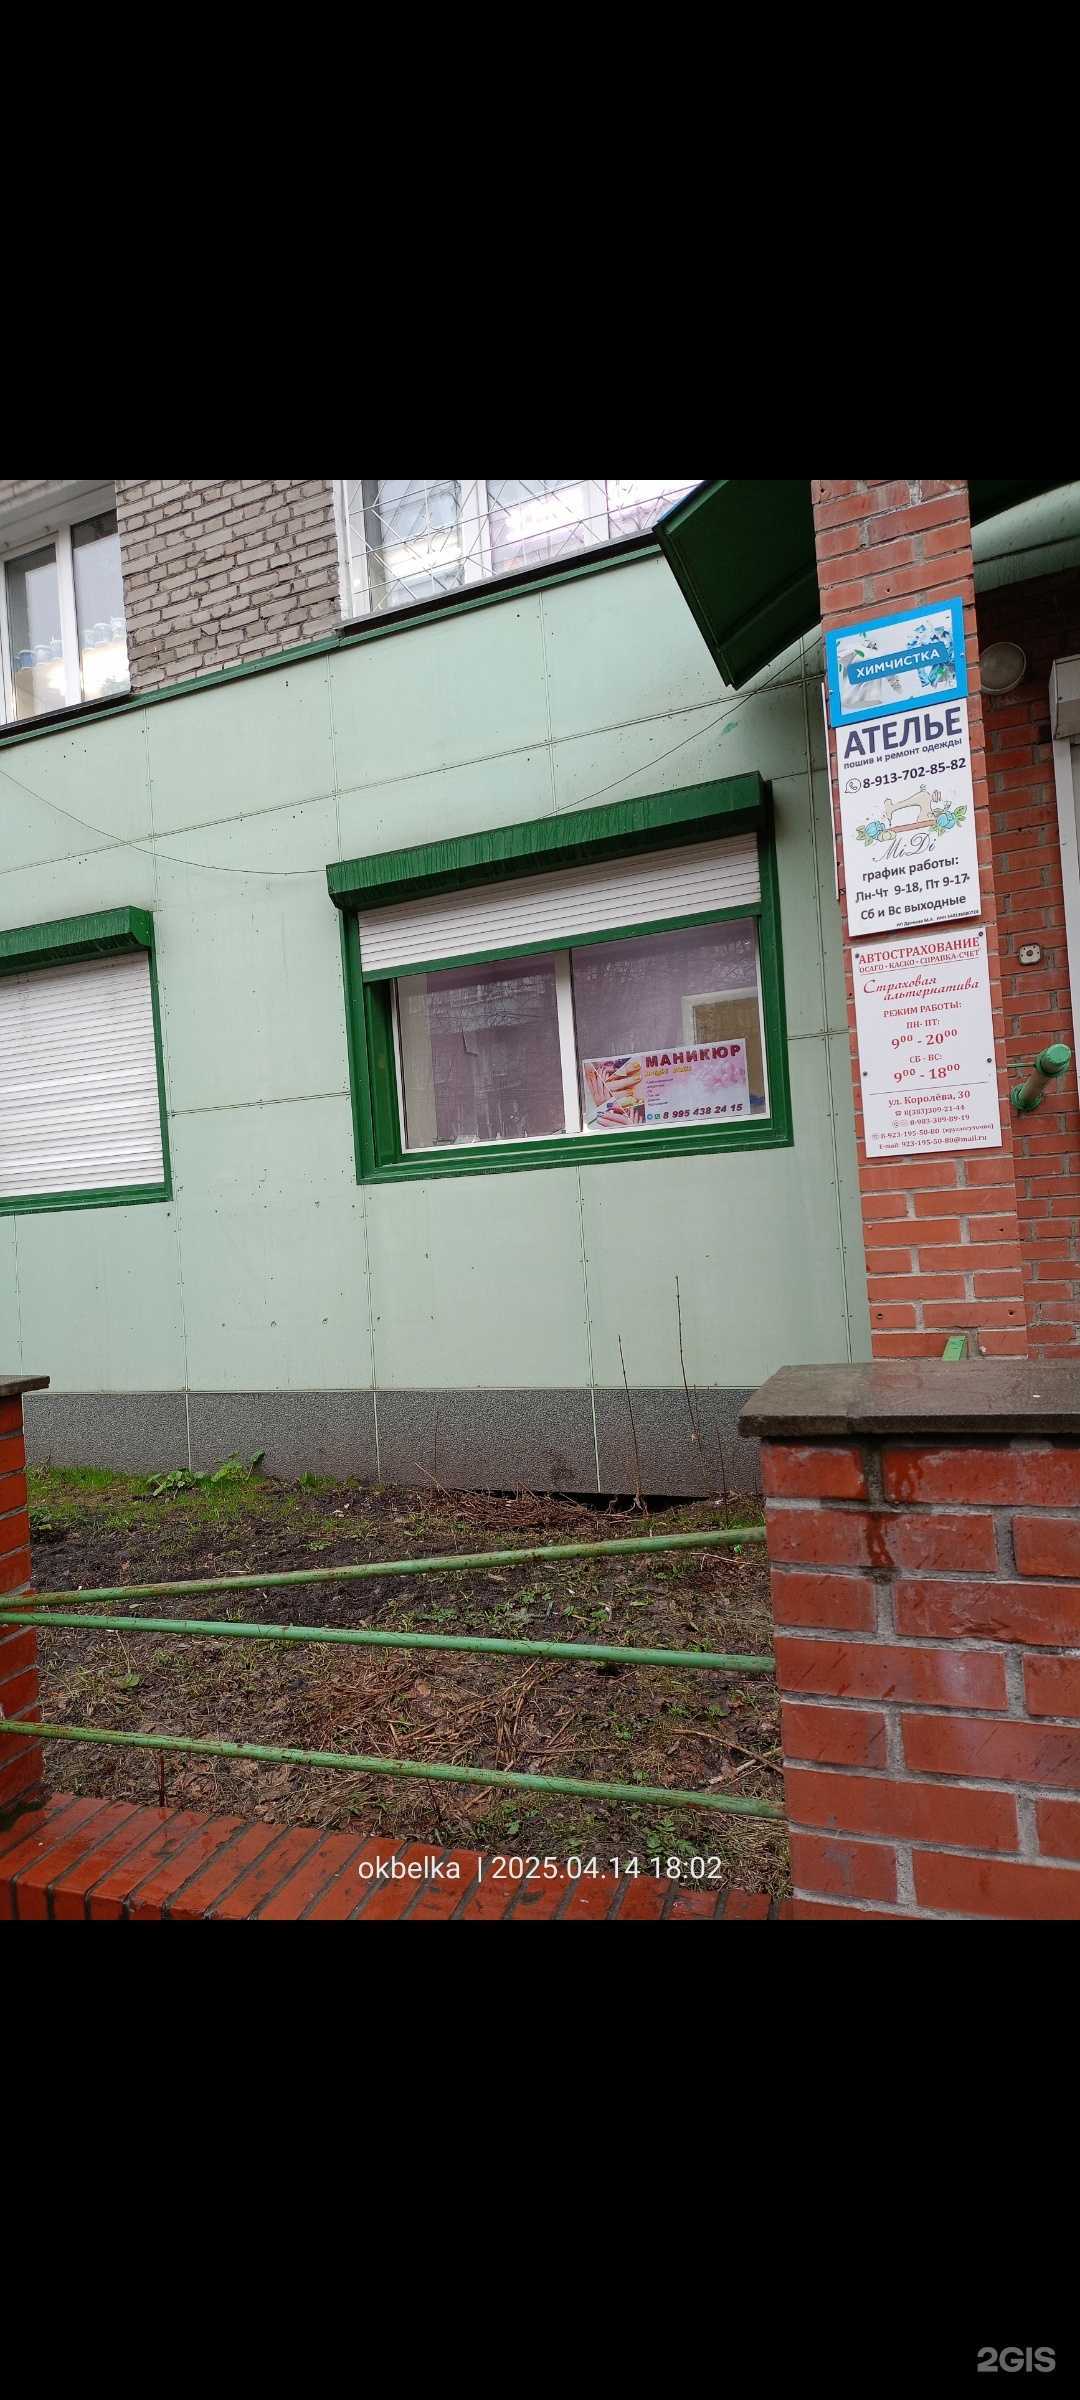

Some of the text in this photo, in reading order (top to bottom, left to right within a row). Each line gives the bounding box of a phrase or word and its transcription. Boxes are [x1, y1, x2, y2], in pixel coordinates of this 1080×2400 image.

[856, 649, 940, 678] ХИМЧИСТКА
[843, 706, 962, 759] АТЕЛЬЕ
[844, 738, 962, 770] пошив и ремонт одежды
[863, 757, 967, 789] 8-913-702-85-82
[862, 856, 959, 883] график работы:
[855, 888, 889, 904] Пн-Чт
[894, 882, 922, 896] 9-18,
[926, 879, 940, 890] Пт
[861, 908, 875, 921] Сб
[878, 909, 885, 918] и
[888, 905, 901, 917] Вс
[904, 895, 967, 914] выходные
[859, 937, 980, 965] АВТОСТРАХОВАНИЕ
[859, 964, 884, 973] ОСАГО
[889, 959, 915, 970] КАСКО
[863, 974, 936, 994] Страховая
[883, 977, 980, 1001] альтернатива
[883, 1001, 962, 1018] РЕЖИМ РАБОТЫ:
[645, 1045, 741, 1068] МАНИКЮР
[909, 1055, 921, 1064] СБ
[904, 1092, 956, 1107] Королёва,
[958, 1090, 970, 1099] 30
[663, 1104, 743, 1120] 8 995 438 24 15
